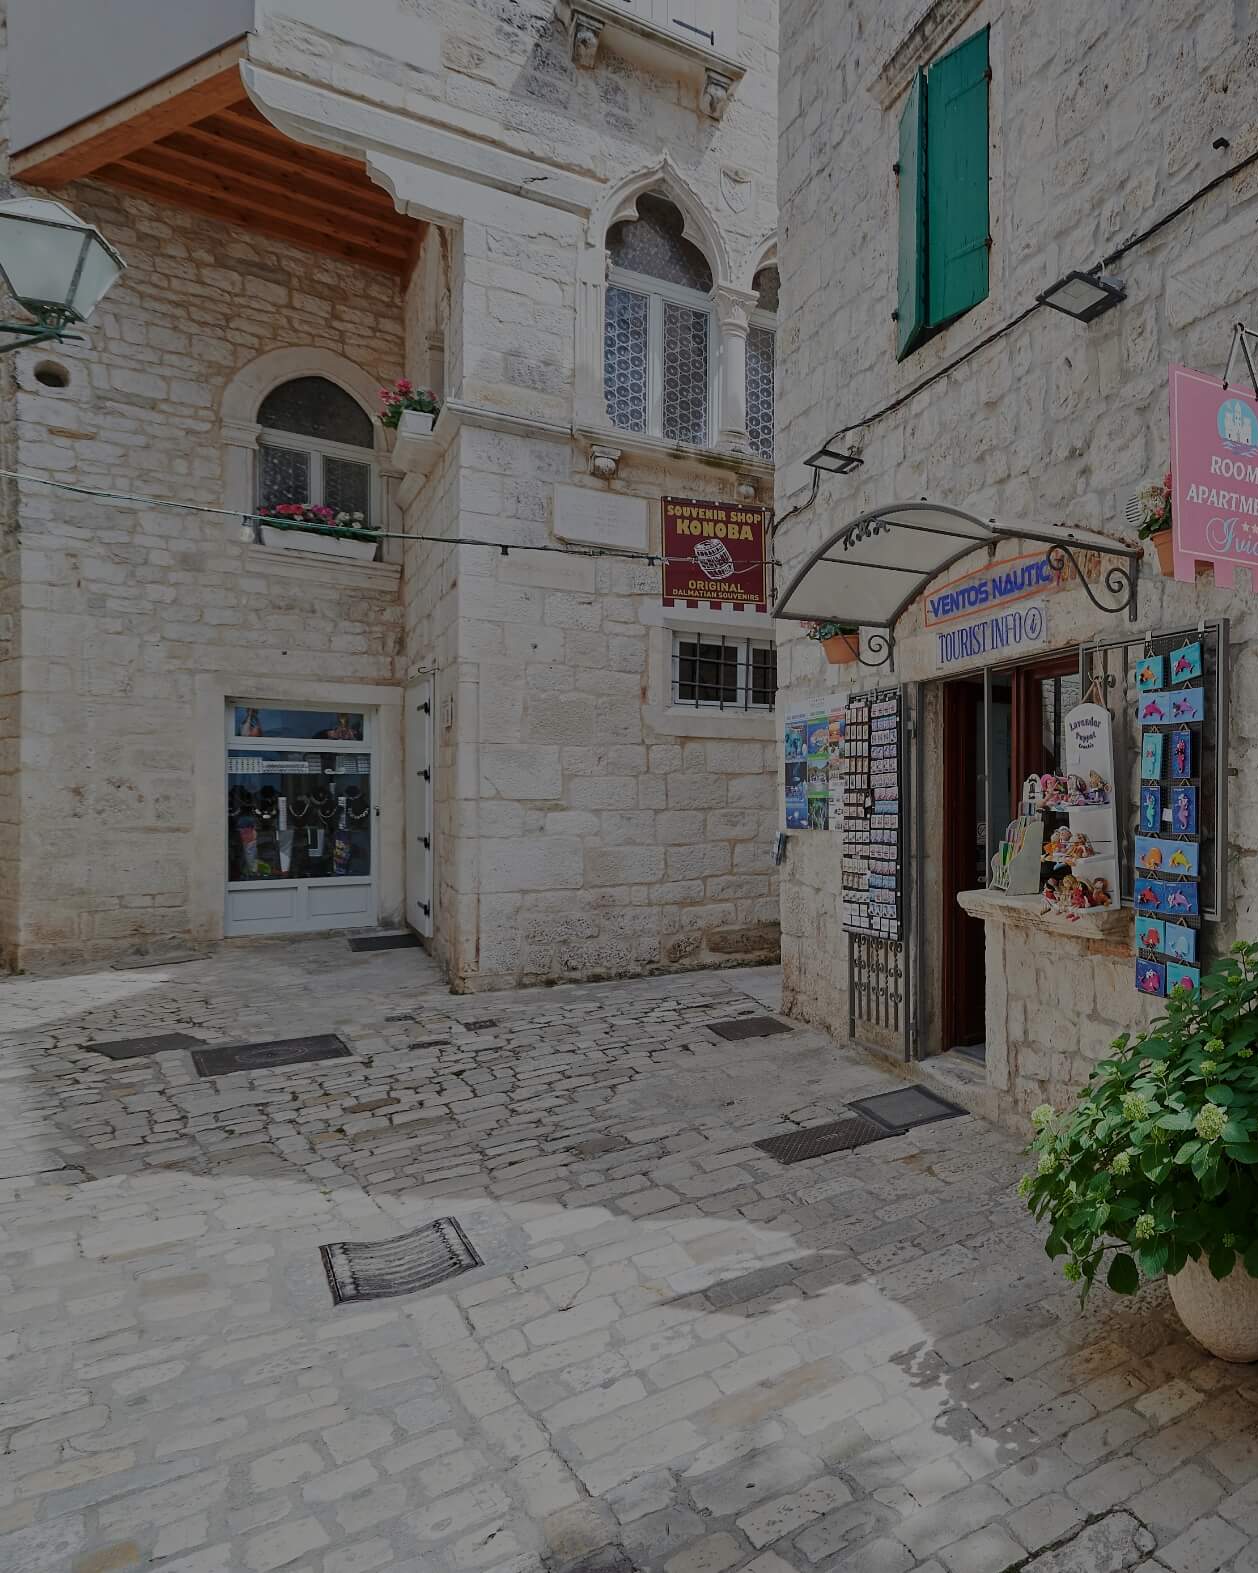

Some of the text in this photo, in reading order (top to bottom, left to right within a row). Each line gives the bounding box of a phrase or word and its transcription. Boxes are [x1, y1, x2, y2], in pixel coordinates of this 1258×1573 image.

[667, 505, 762, 524] SOUVENIR SHOP
[676, 519, 754, 541] KONOBA
[672, 589, 760, 601] DALMATIAN SOUVENIRS
[688, 580, 744, 593] ORIGINAL
[930, 581, 988, 618] VENTOS
[938, 621, 988, 664] TOURIST
[991, 612, 1022, 651] INFO
